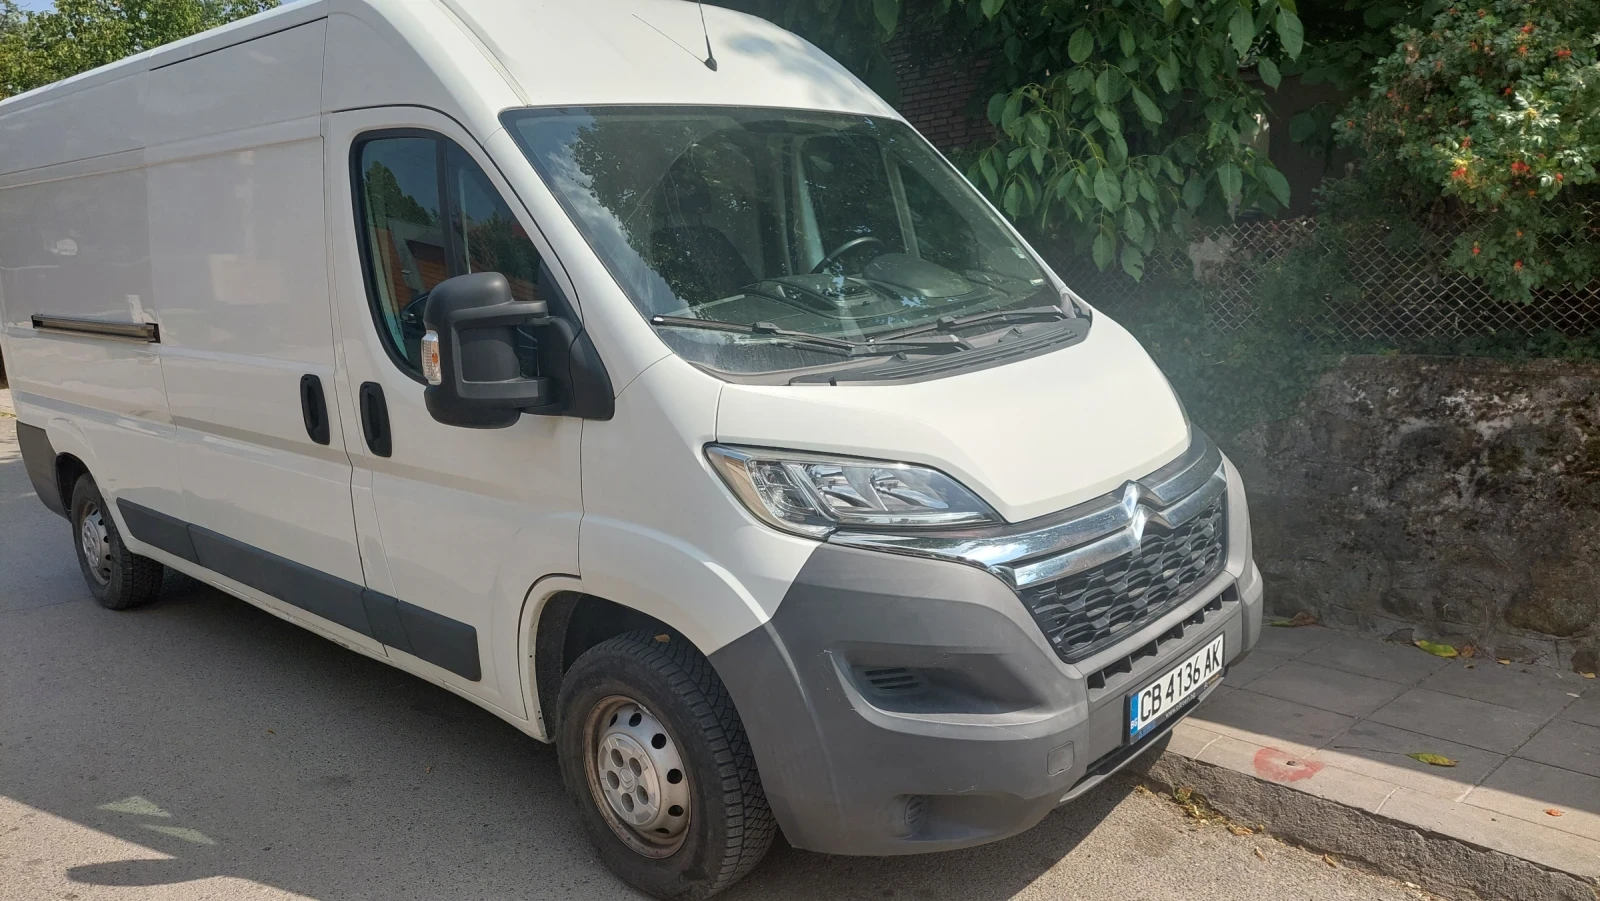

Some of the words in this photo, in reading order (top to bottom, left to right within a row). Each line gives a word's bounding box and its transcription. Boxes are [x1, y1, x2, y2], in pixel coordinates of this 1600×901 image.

[1141, 683, 1161, 722] CB
[1166, 655, 1201, 703] 4136
[1204, 640, 1220, 678] AK
[1131, 718, 1138, 730] BG
